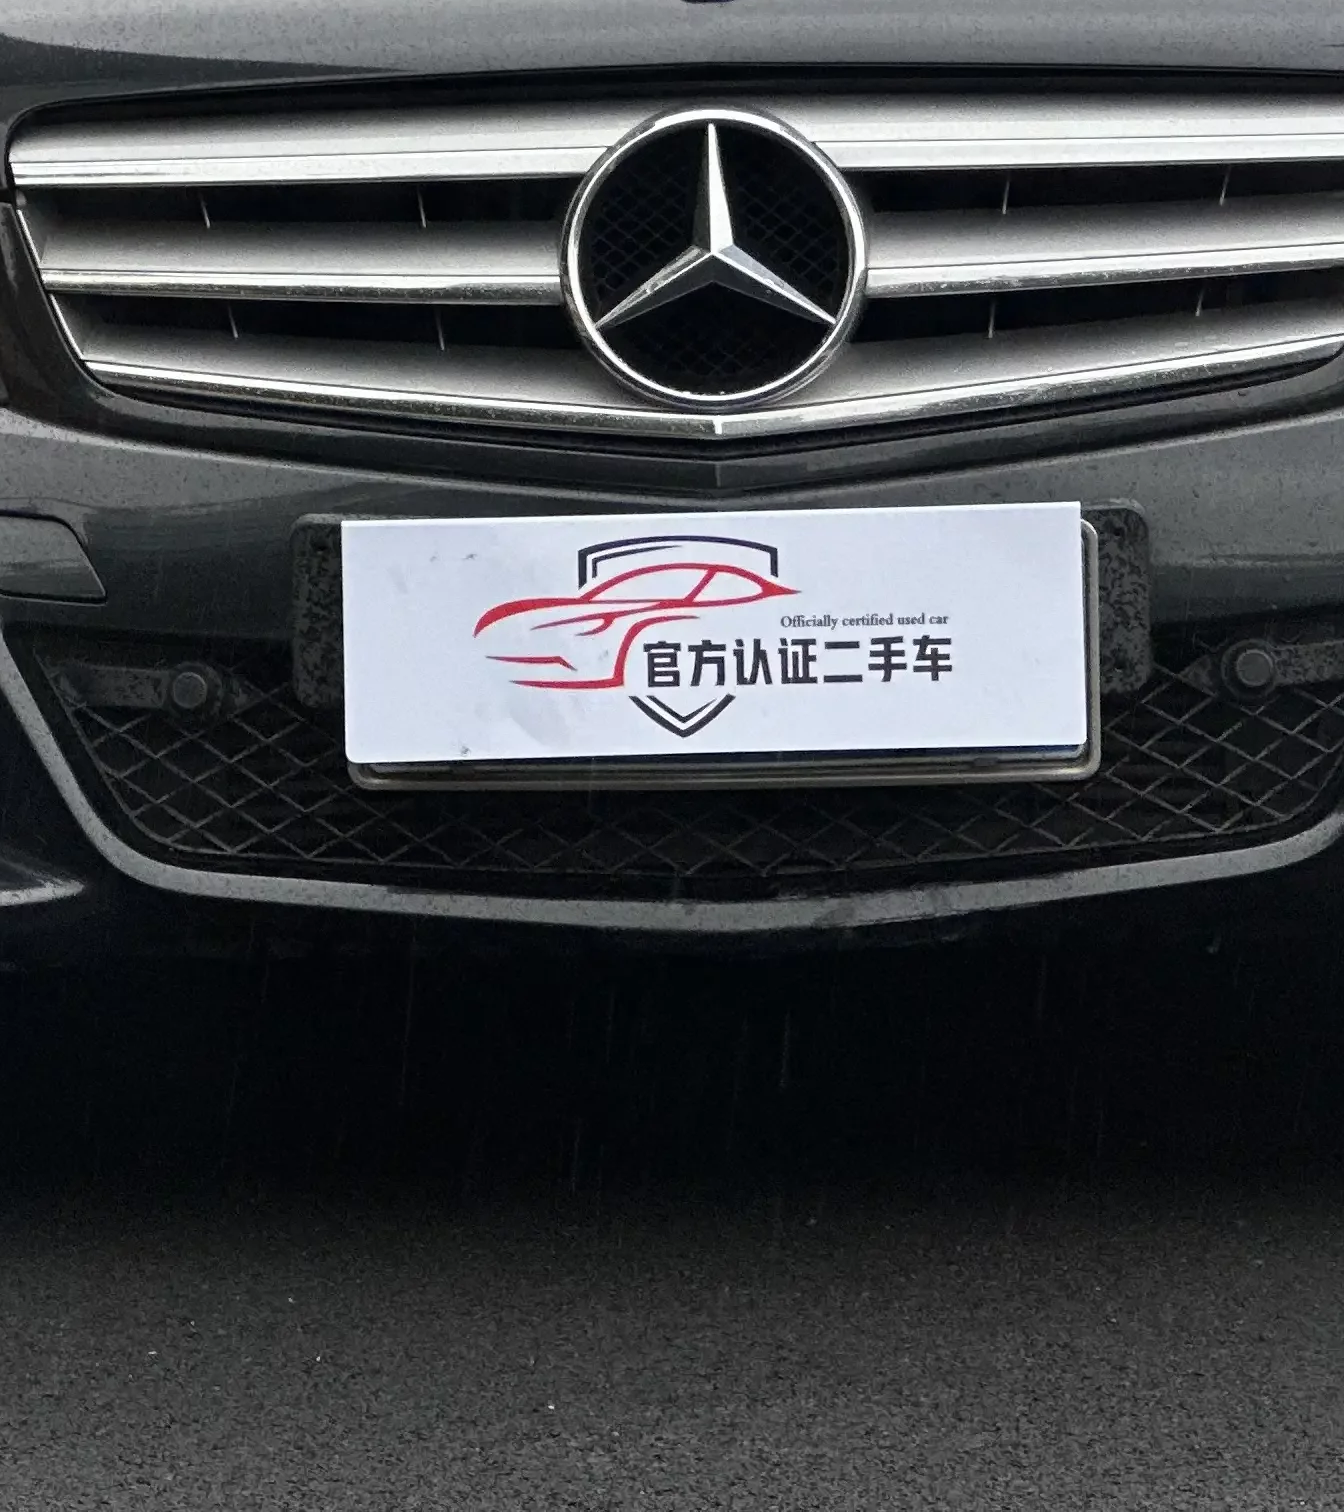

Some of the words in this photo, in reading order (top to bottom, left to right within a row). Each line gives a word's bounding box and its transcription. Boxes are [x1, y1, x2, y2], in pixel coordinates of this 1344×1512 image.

[780, 614, 838, 630] Officially
[842, 613, 893, 626] certified
[897, 612, 925, 625] used
[929, 615, 949, 625] car
[643, 635, 953, 688] 官方认证二手车
